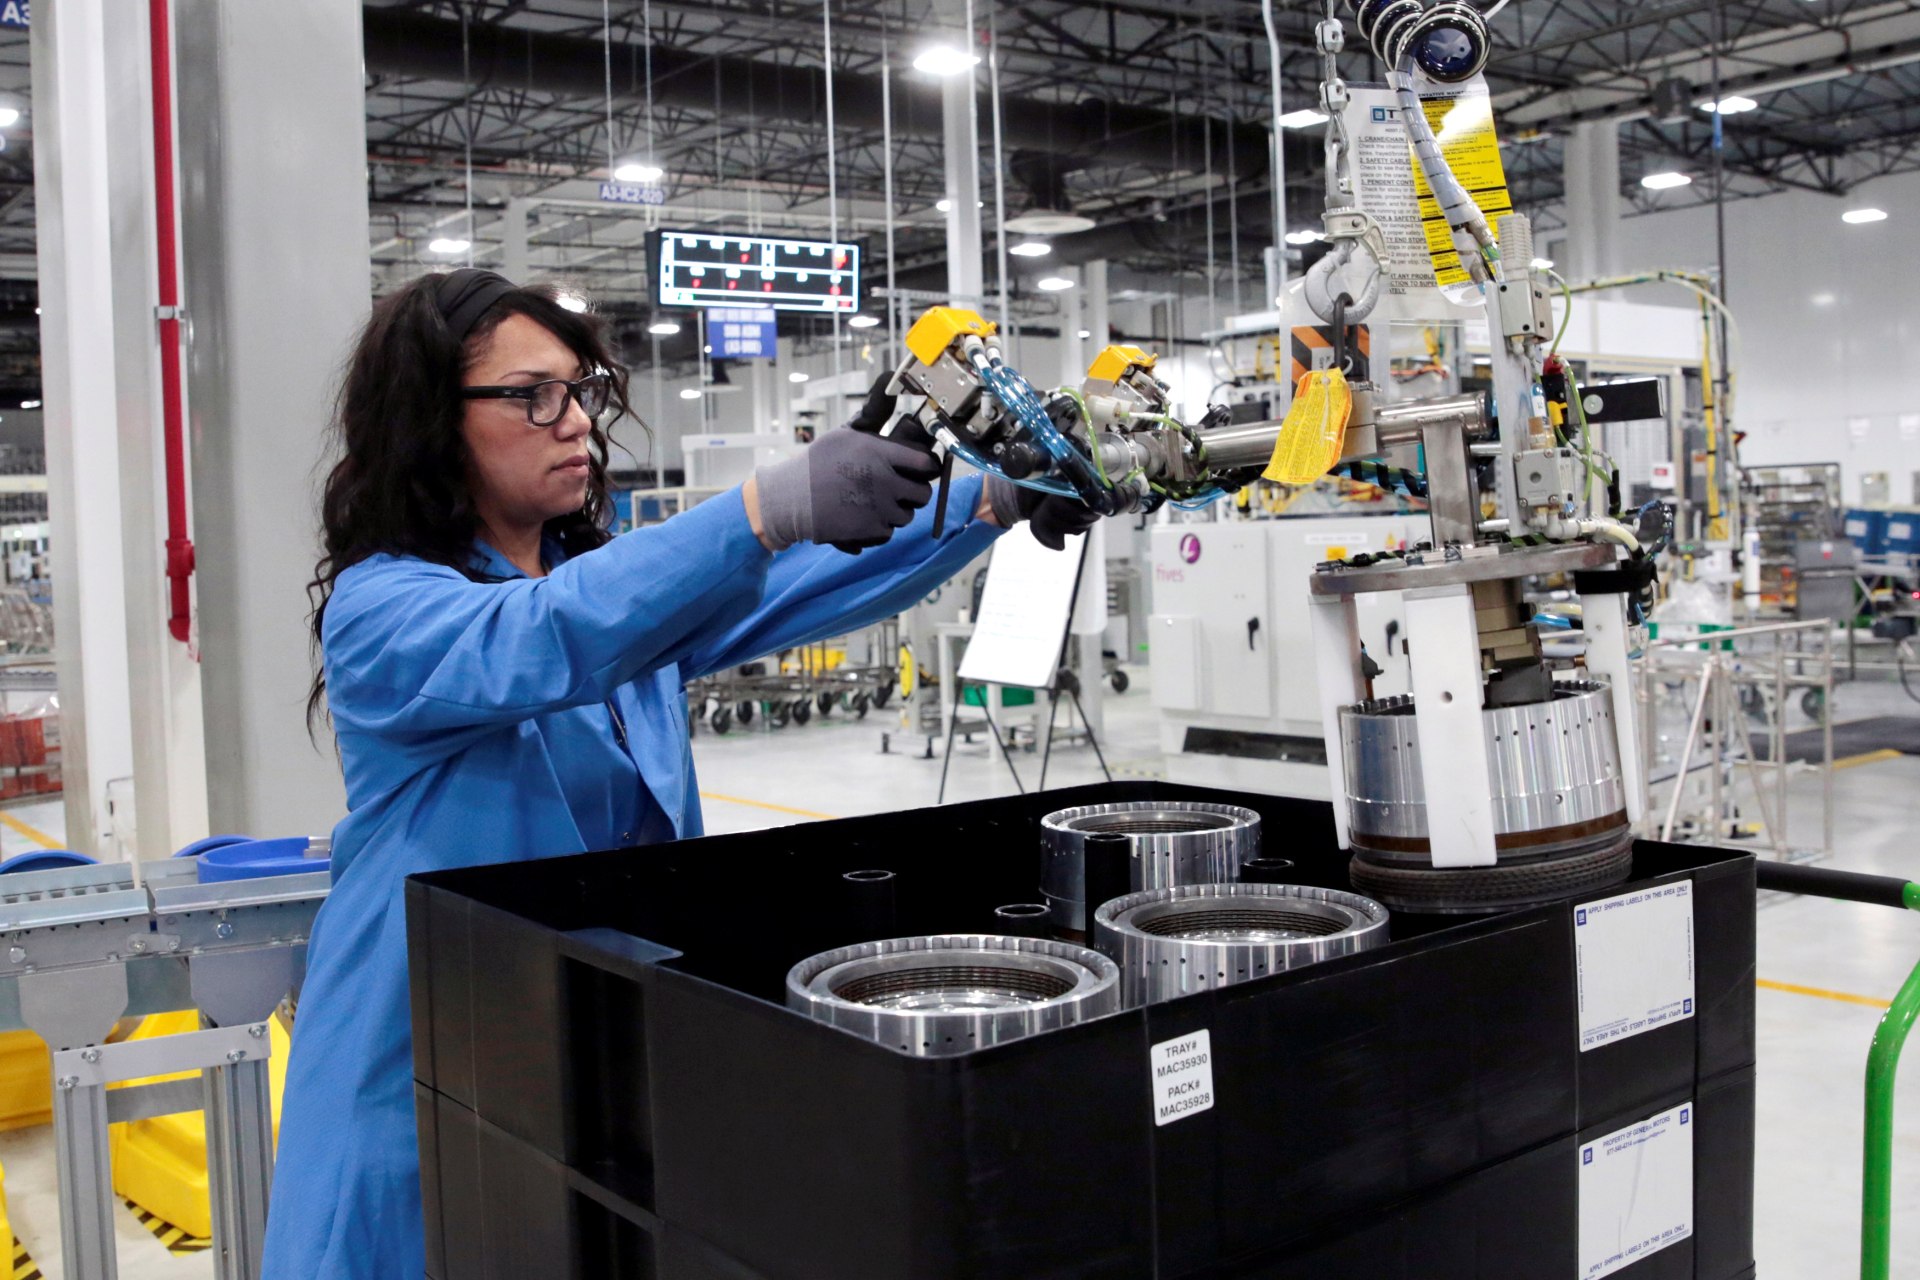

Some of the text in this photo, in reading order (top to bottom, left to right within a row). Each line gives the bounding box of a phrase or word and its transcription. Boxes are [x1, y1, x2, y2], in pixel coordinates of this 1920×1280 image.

[1604, 900, 1624, 910] SHIPPING
[1626, 896, 1642, 905] LABELS
[1596, 1032, 1608, 1041] AREA
[1166, 1040, 1196, 1058] TRAY#
[1157, 1054, 1207, 1077] MAC35930
[1168, 1080, 1200, 1098] PACK#
[1160, 1093, 1210, 1118] MAC35928
[1603, 1134, 1625, 1148] PROPERTY
[1653, 1116, 1671, 1127] MOTORS
[1590, 1262, 1602, 1273] APPLY
[1604, 1253, 1623, 1266] SHIPPING
[1625, 1244, 1641, 1256] LABELS
[1661, 1229, 1672, 1239] AREA
[1674, 1224, 1685, 1233] ONLY
